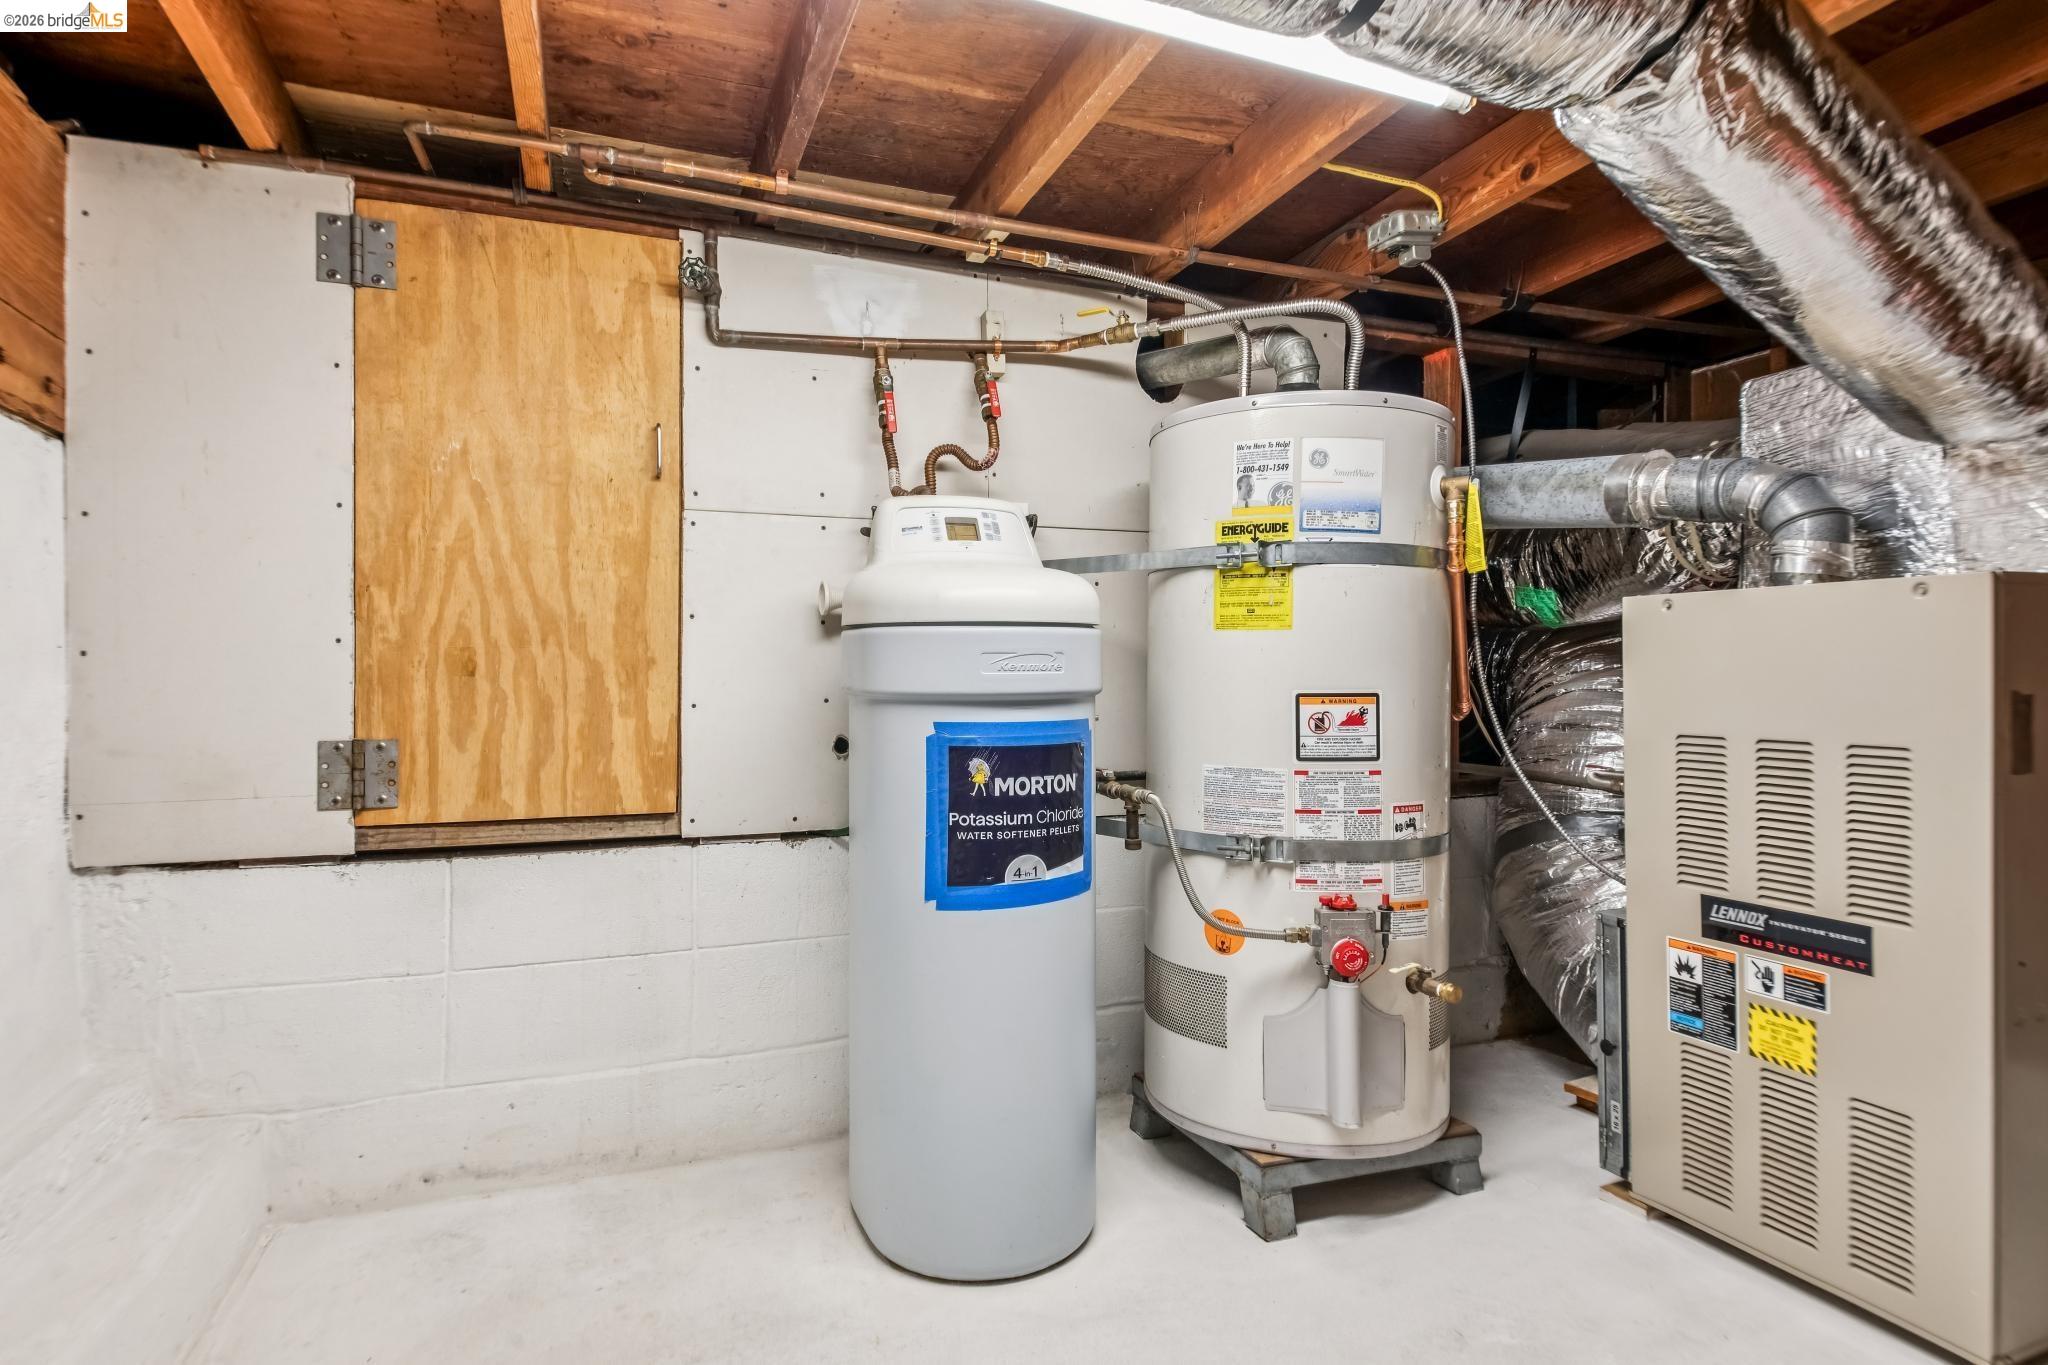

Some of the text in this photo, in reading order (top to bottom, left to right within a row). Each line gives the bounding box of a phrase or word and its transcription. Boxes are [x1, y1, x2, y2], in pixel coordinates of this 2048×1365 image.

[1275, 441, 1291, 449] Help!
[1236, 463, 1290, 474] 1-800-431-1549
[997, 661, 1064, 672] Kenmore
[994, 773, 1076, 797] MORTON
[949, 805, 1083, 826] Potassium Chloride
[957, 824, 1080, 840] WATER SOFTENER PELLETS
[1013, 866, 1039, 879] 4-in-1
[1710, 904, 1769, 927] LENNOX
